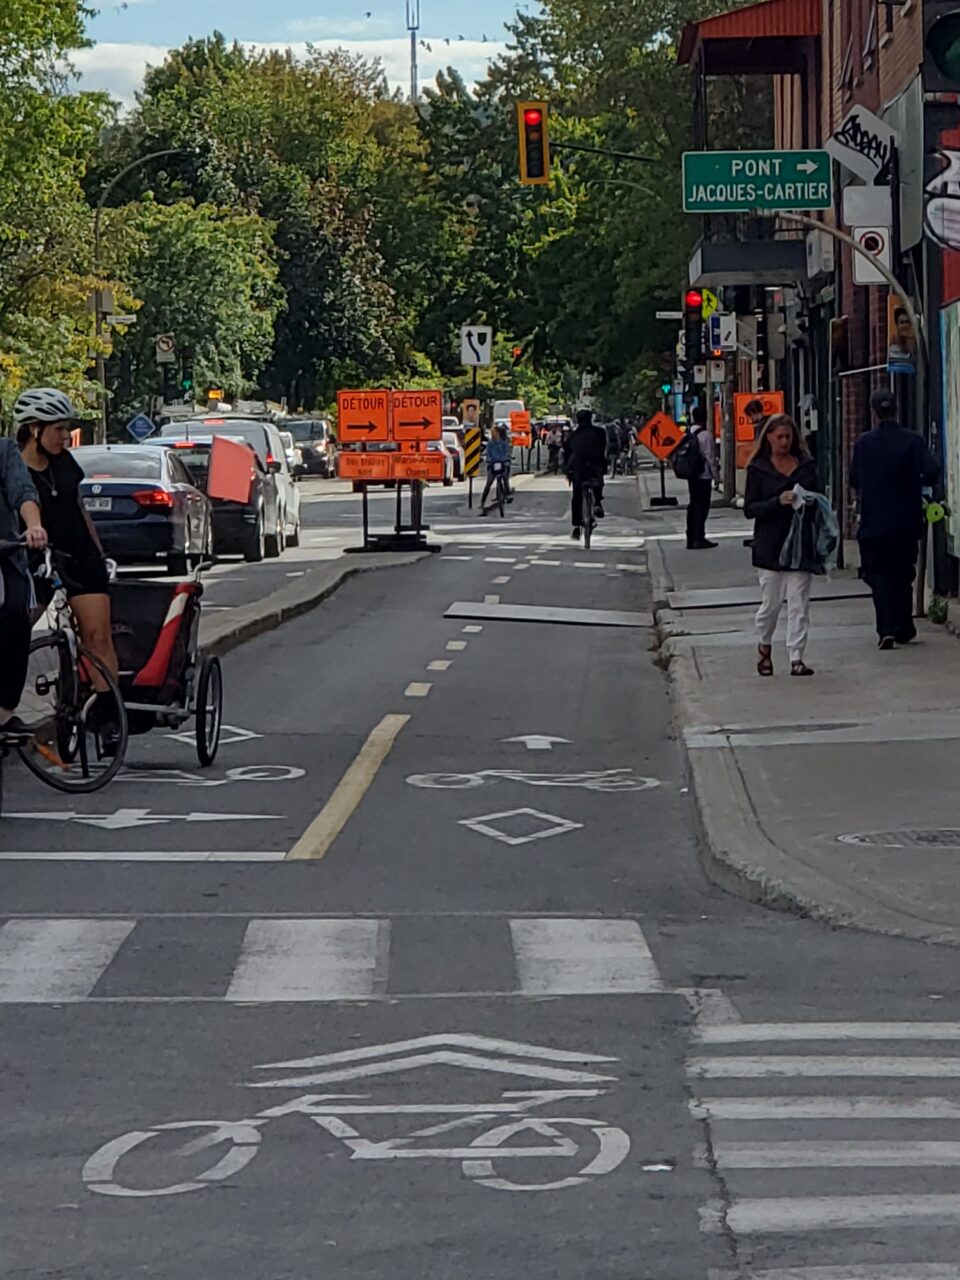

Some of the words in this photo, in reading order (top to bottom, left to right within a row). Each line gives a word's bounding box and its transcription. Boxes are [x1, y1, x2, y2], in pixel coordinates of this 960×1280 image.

[731, 159, 783, 177] PONT
[687, 182, 828, 203] JACQUES-CARTIER
[342, 396, 385, 411] DÉTOUR
[394, 394, 438, 409] DÉTOUR
